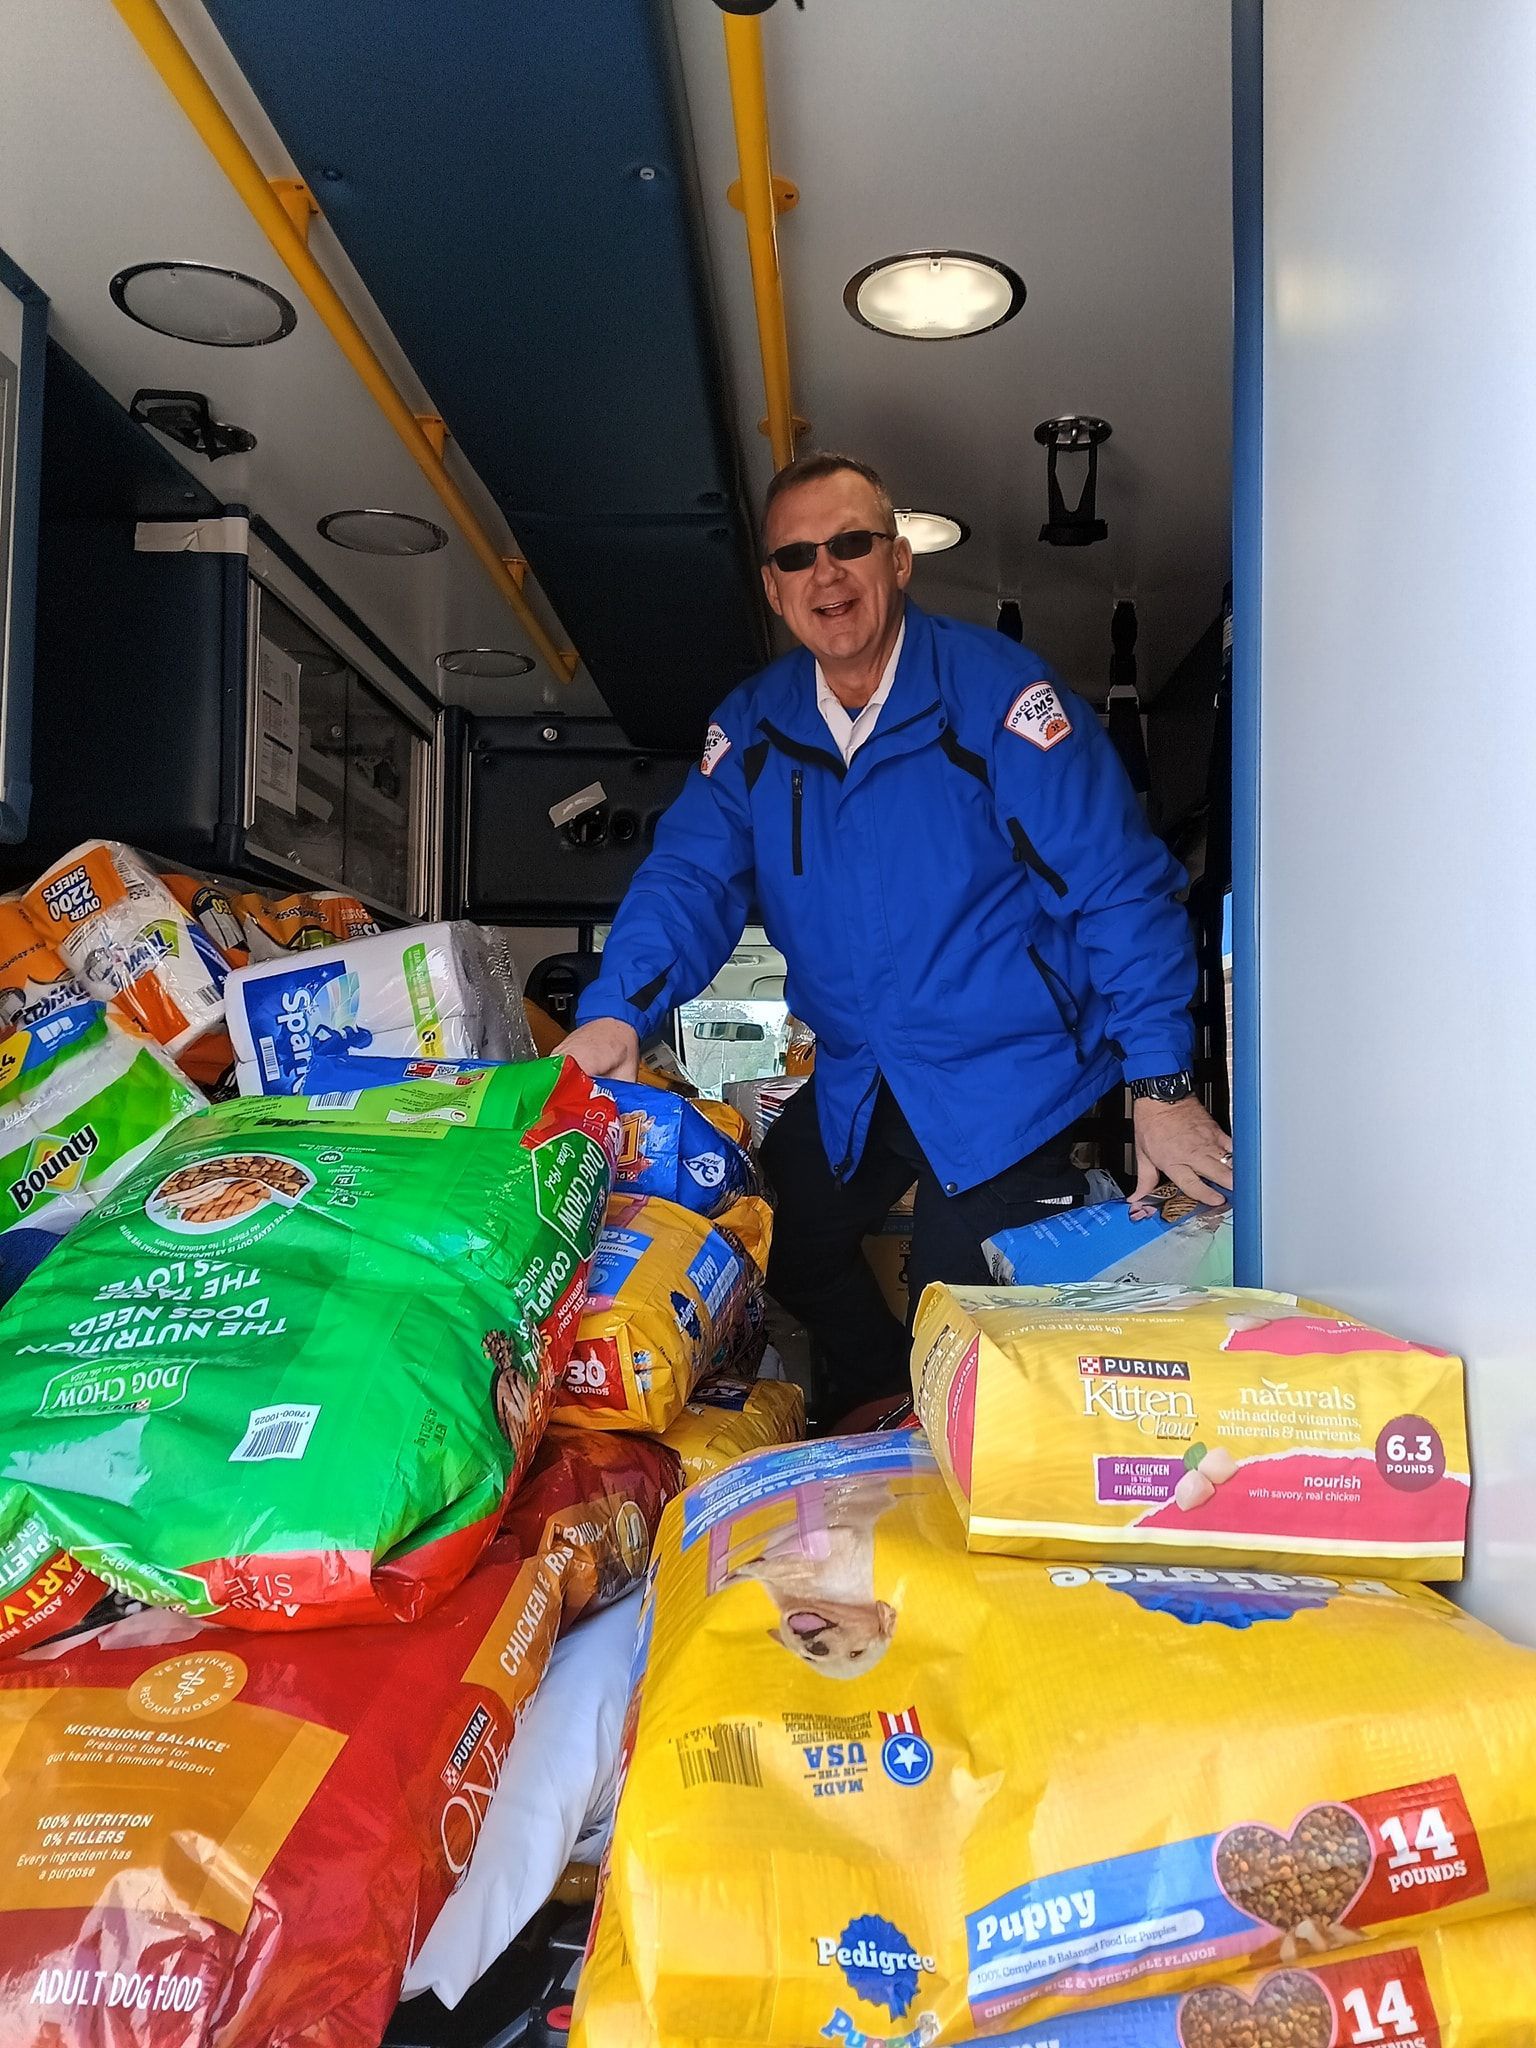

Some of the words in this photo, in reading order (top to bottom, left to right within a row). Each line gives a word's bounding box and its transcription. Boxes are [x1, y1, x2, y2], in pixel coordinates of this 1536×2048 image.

[1011, 701, 1030, 728] IOSCO
[1024, 694, 1054, 721] EMS
[42, 866, 86, 902] SHEETS
[49, 878, 95, 921] 2200
[69, 897, 101, 922] OVER
[9, 1125, 98, 1211] Bounty
[579, 1141, 604, 1186] DOG
[557, 1176, 592, 1239] CHOW
[237, 1238, 255, 1250] OUT
[253, 1221, 277, 1242] LEAVE
[215, 1247, 228, 1257] AS
[200, 1268, 262, 1299] THE
[169, 1297, 270, 1320] DOGS
[557, 1279, 585, 1319] NUTRITION
[69, 1304, 165, 1337] NEED.
[217, 1317, 287, 1337] THE
[1105, 1323, 1123, 1335] kg)
[15, 1321, 213, 1356] NUTRITION
[132, 1365, 184, 1394] DOG
[566, 1358, 607, 1385] 30
[1104, 1358, 1184, 1376] PURINA
[51, 1377, 126, 1409] CHOW
[1080, 1378, 1197, 1421] Kitten
[1238, 1377, 1357, 1410] naturals
[1138, 1414, 1195, 1437] Chow
[1218, 1408, 1250, 1422] with
[1252, 1410, 1296, 1424] added
[1298, 1413, 1362, 1429] vitamins,
[1216, 1424, 1280, 1438] minerals
[1281, 1426, 1294, 1438] &
[1295, 1427, 1361, 1442] nutrients
[1386, 1434, 1432, 1461] 6.3
[1114, 1463, 1135, 1475] REAL
[1135, 1463, 1169, 1476] CHICKEN
[1304, 1474, 1361, 1490] nourish
[1386, 1463, 1434, 1475] POUNDS
[1122, 1485, 1169, 1497] INGREDIENT
[1249, 1488, 1269, 1498] with
[1270, 1489, 1303, 1502] savory,
[1305, 1490, 1323, 1501] real
[1325, 1491, 1361, 1502] chicken
[23, 1597, 63, 1630] ADULT
[500, 1590, 548, 1676] CHICKEN
[154, 1657, 236, 1689] VETERINARIAN
[139, 1685, 221, 1716] RECOMMENDED
[782, 1711, 813, 1722] WORLD
[785, 1722, 812, 1733] FROM
[64, 1724, 154, 1741] MICROBIOME
[452, 1711, 489, 1771] PURINA
[791, 1732, 825, 1745] FINEST
[827, 1730, 847, 1741] THE
[848, 1730, 870, 1739] WITH
[84, 1738, 136, 1753] Prebiotic
[139, 1741, 167, 1754] fiber
[170, 1746, 189, 1758] for
[803, 1742, 867, 1770] USA
[46, 1751, 64, 1766] gut
[67, 1751, 102, 1763] health
[105, 1753, 113, 1763] &
[116, 1753, 164, 1766] immune
[167, 1758, 215, 1776] support
[818, 1769, 840, 1778] THE
[843, 1768, 855, 1776] IN
[813, 1778, 864, 1798] MADE
[36, 1813, 70, 1830] 100%
[73, 1813, 154, 1828] NUTRITION
[42, 1832, 62, 1848] 0%
[65, 1830, 125, 1846] FILLERS
[1379, 1807, 1458, 1869] 14
[16, 1853, 48, 1867] Every
[50, 1849, 108, 1864] ingredient
[110, 1849, 133, 1860] has
[38, 1870, 46, 1880] a
[48, 1866, 96, 1882] purpose
[1388, 1860, 1468, 1893] POUNDS
[976, 1889, 1096, 1951] Puppy
[816, 1937, 936, 1976] Pedigree
[977, 1967, 1002, 1984] 100%
[1002, 1957, 1047, 1978] Complete
[1048, 1955, 1056, 1965] &
[1057, 1942, 1099, 1963] Balanced
[1100, 1934, 1122, 1950] Food
[1123, 1933, 1138, 1945] for
[1139, 1924, 1178, 1943] Puppies
[1076, 1976, 1087, 1989] &
[1087, 1957, 1162, 1988] VEGETABLE
[1164, 1946, 1217, 1968] FLAVOR
[30, 1968, 106, 2006] ADULT
[106, 1972, 153, 2011] DOG
[152, 1974, 203, 2012] FOOD
[1342, 1979, 1419, 2044] 14
